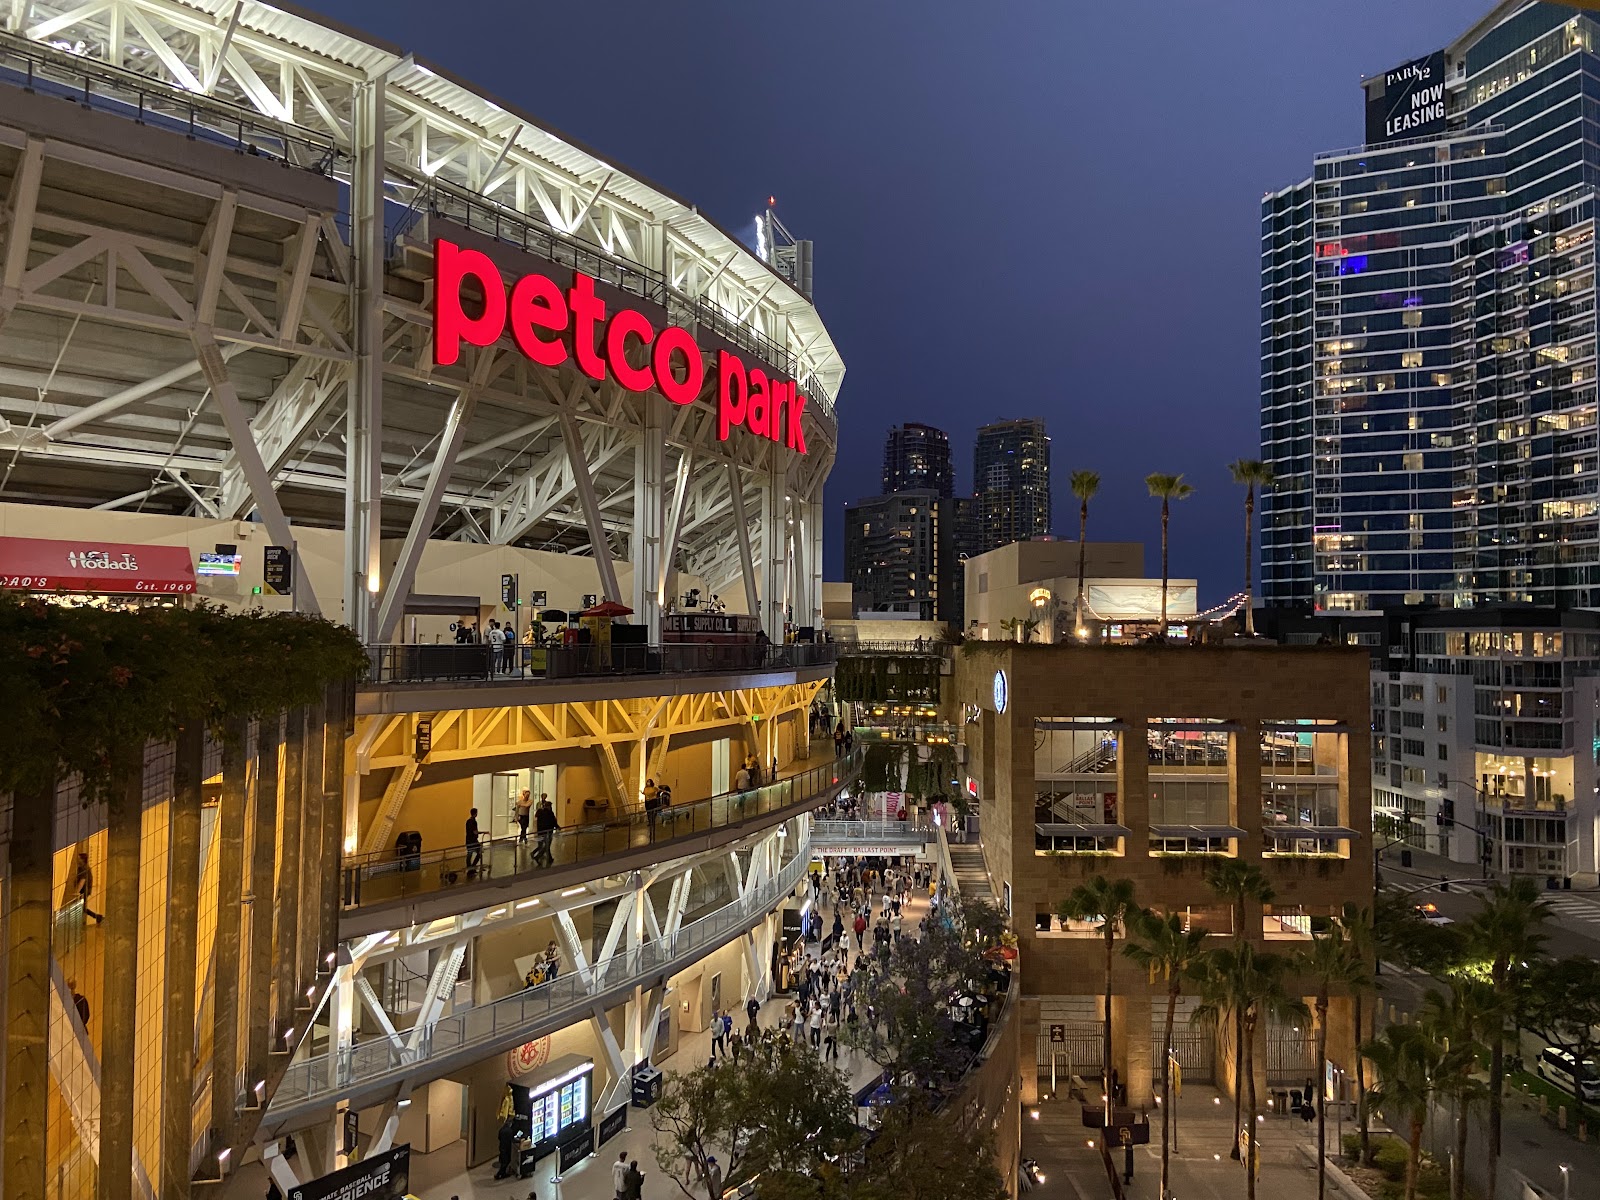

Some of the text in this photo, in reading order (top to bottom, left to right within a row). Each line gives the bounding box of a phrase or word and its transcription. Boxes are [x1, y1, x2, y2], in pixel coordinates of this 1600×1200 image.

[1387, 64, 1431, 86] PARK 12
[1411, 83, 1443, 110] NOW
[1386, 102, 1444, 137] LEASING
[433, 238, 808, 454] petco park
[163, 583, 192, 592] 1969
[694, 616, 715, 631] SUPPLY
[340, 1173, 372, 1194] BASEBALL
